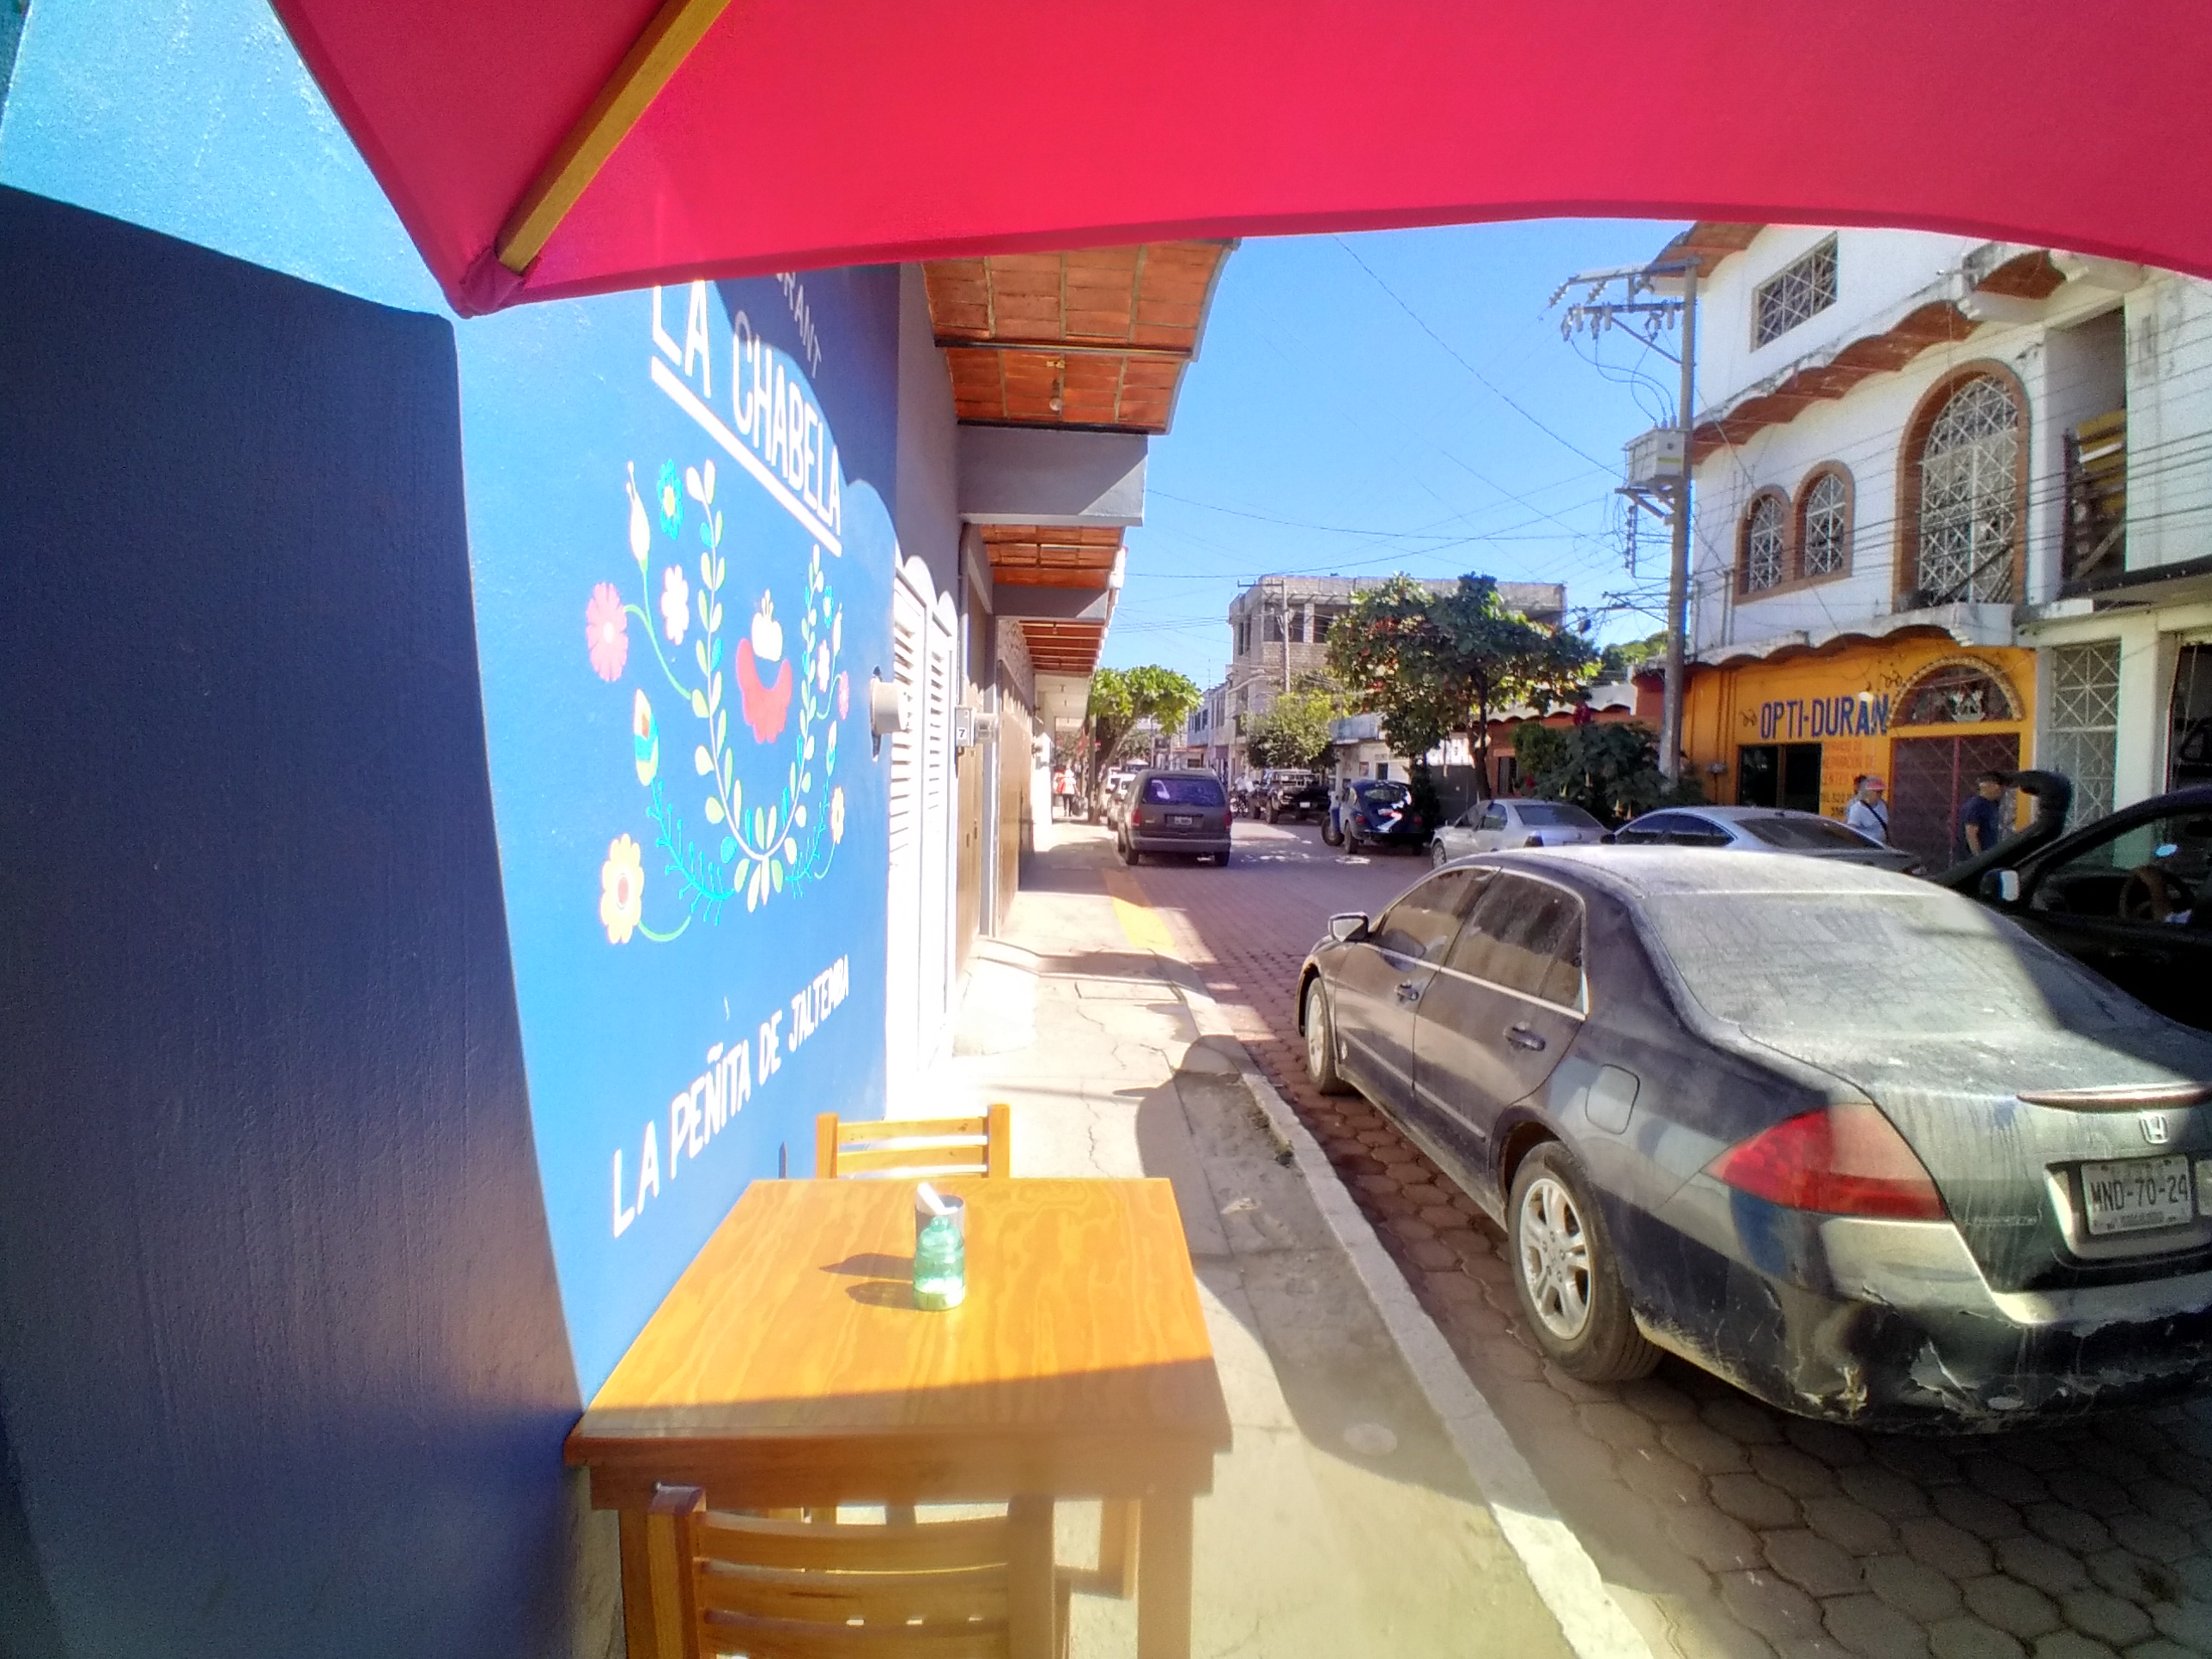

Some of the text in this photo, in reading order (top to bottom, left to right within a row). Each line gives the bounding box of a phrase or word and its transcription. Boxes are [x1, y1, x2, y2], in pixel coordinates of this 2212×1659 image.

[652, 279, 842, 536] LA CHABELA
[958, 728, 966, 738] 7
[1760, 693, 1889, 739] OPTI-DURAN
[612, 952, 849, 1239] LA PEÑITA DE JALTEMBA
